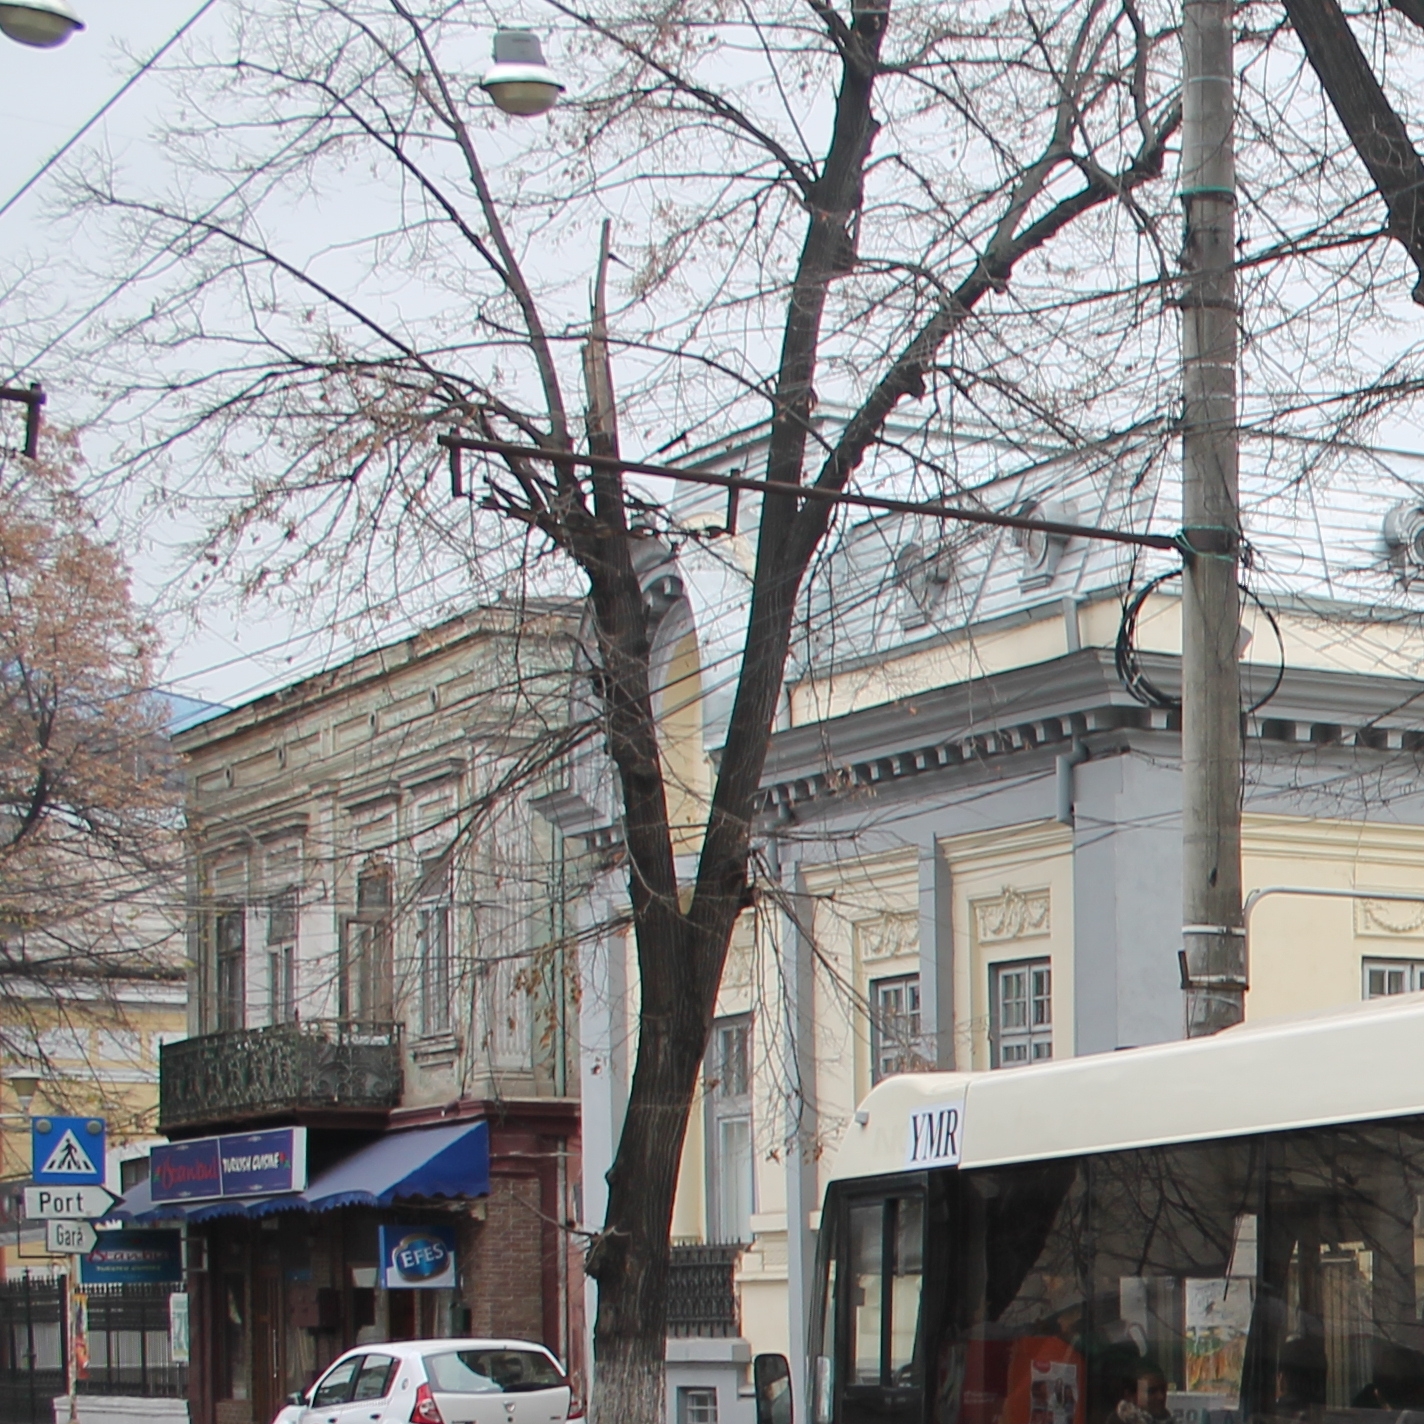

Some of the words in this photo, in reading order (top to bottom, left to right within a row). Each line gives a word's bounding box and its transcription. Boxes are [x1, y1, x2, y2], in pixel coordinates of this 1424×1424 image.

[911, 1108, 958, 1161] YMR
[39, 1191, 83, 1213] Port
[401, 1242, 444, 1268] EFES
